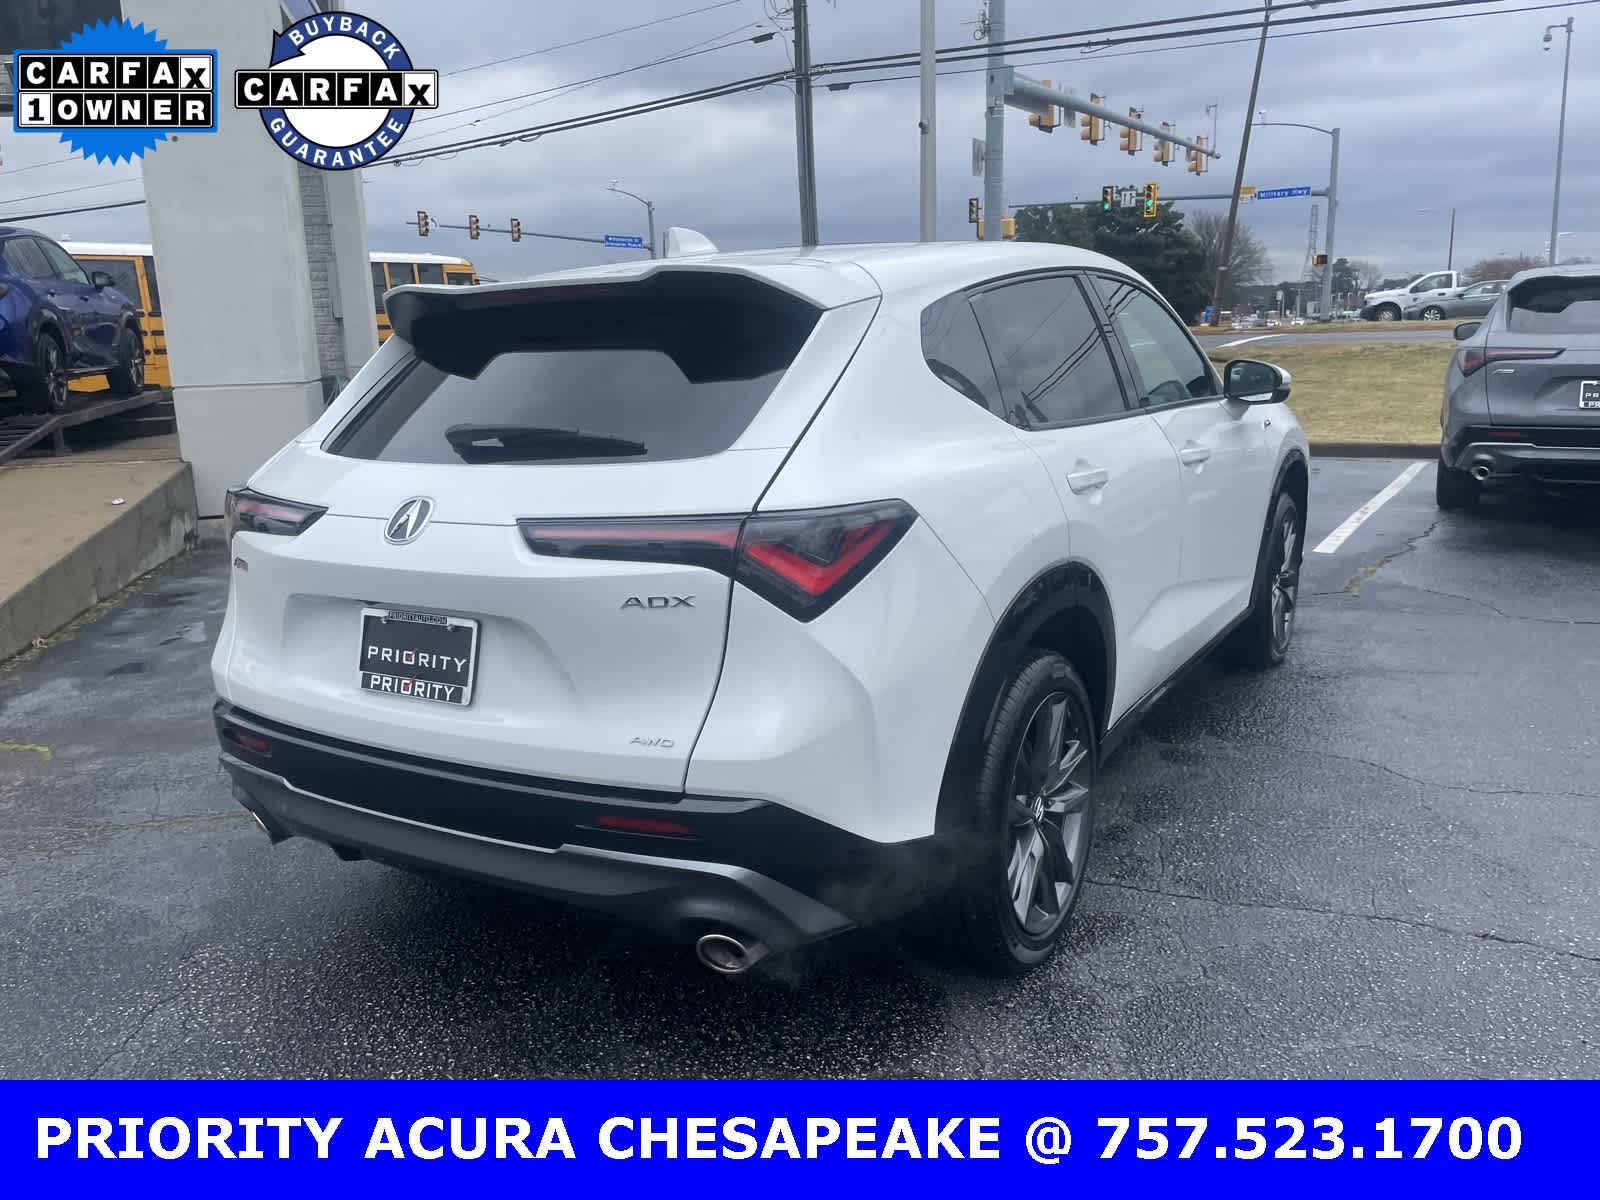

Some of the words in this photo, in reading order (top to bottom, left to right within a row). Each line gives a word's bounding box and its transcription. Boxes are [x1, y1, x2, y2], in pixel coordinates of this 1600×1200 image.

[1260, 190, 1289, 200] Military
[620, 595, 696, 609] ADX
[367, 645, 467, 673] PRIORITY
[370, 674, 455, 701] PRIORITY
[629, 736, 674, 748] AWD
